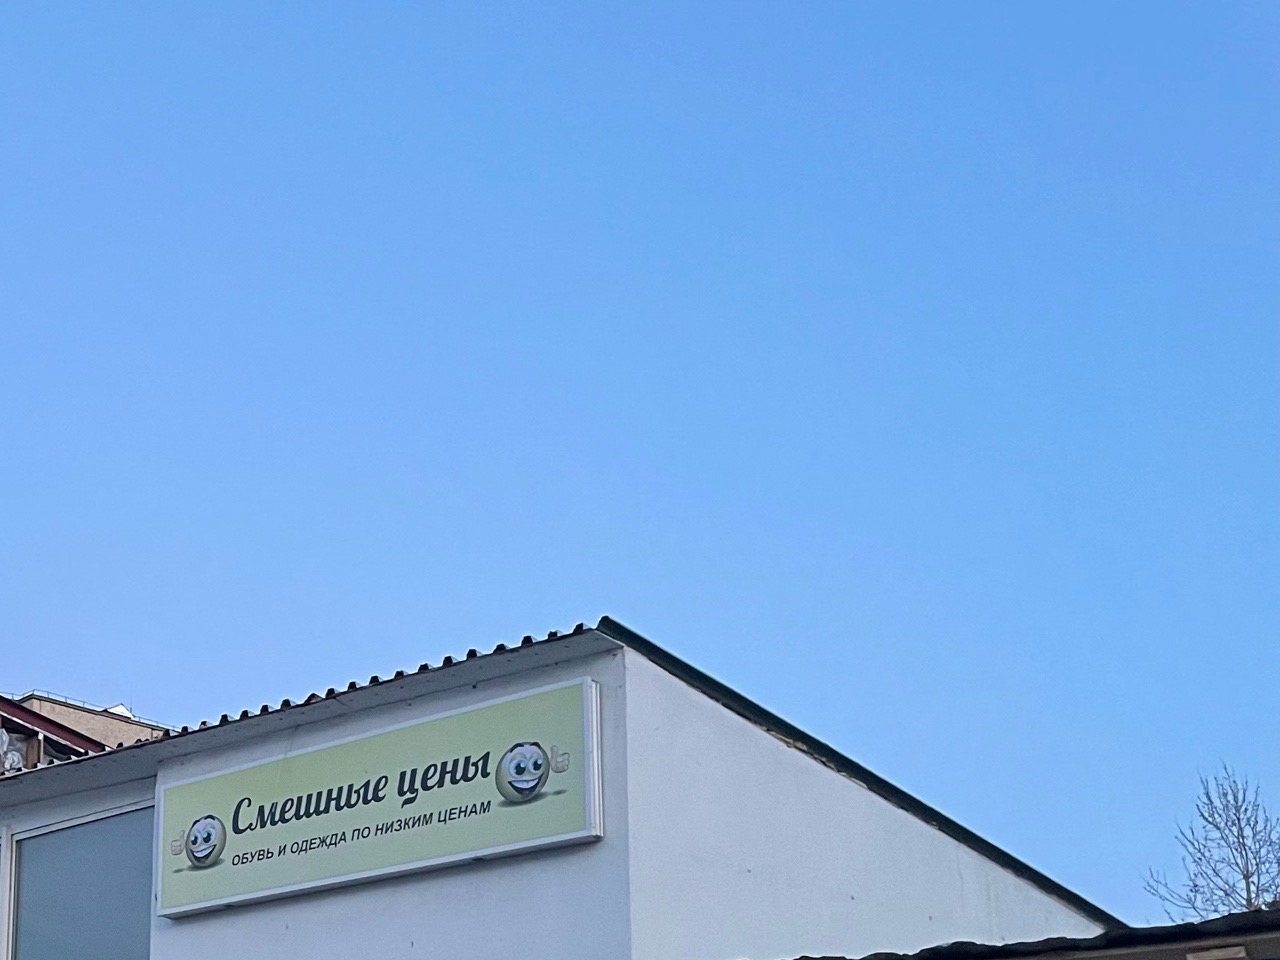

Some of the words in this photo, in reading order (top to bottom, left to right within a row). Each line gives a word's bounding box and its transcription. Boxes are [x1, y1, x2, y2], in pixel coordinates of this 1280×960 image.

[232, 775, 389, 835] Смешные
[397, 751, 491, 809] цены
[231, 848, 274, 866] ОБУВЬ
[277, 844, 287, 857] И
[290, 831, 347, 855] ОДЕЖДА
[351, 826, 371, 841] ПО
[374, 812, 433, 836] НИЗКИМ
[437, 800, 491, 825] ЦЕНАМ
